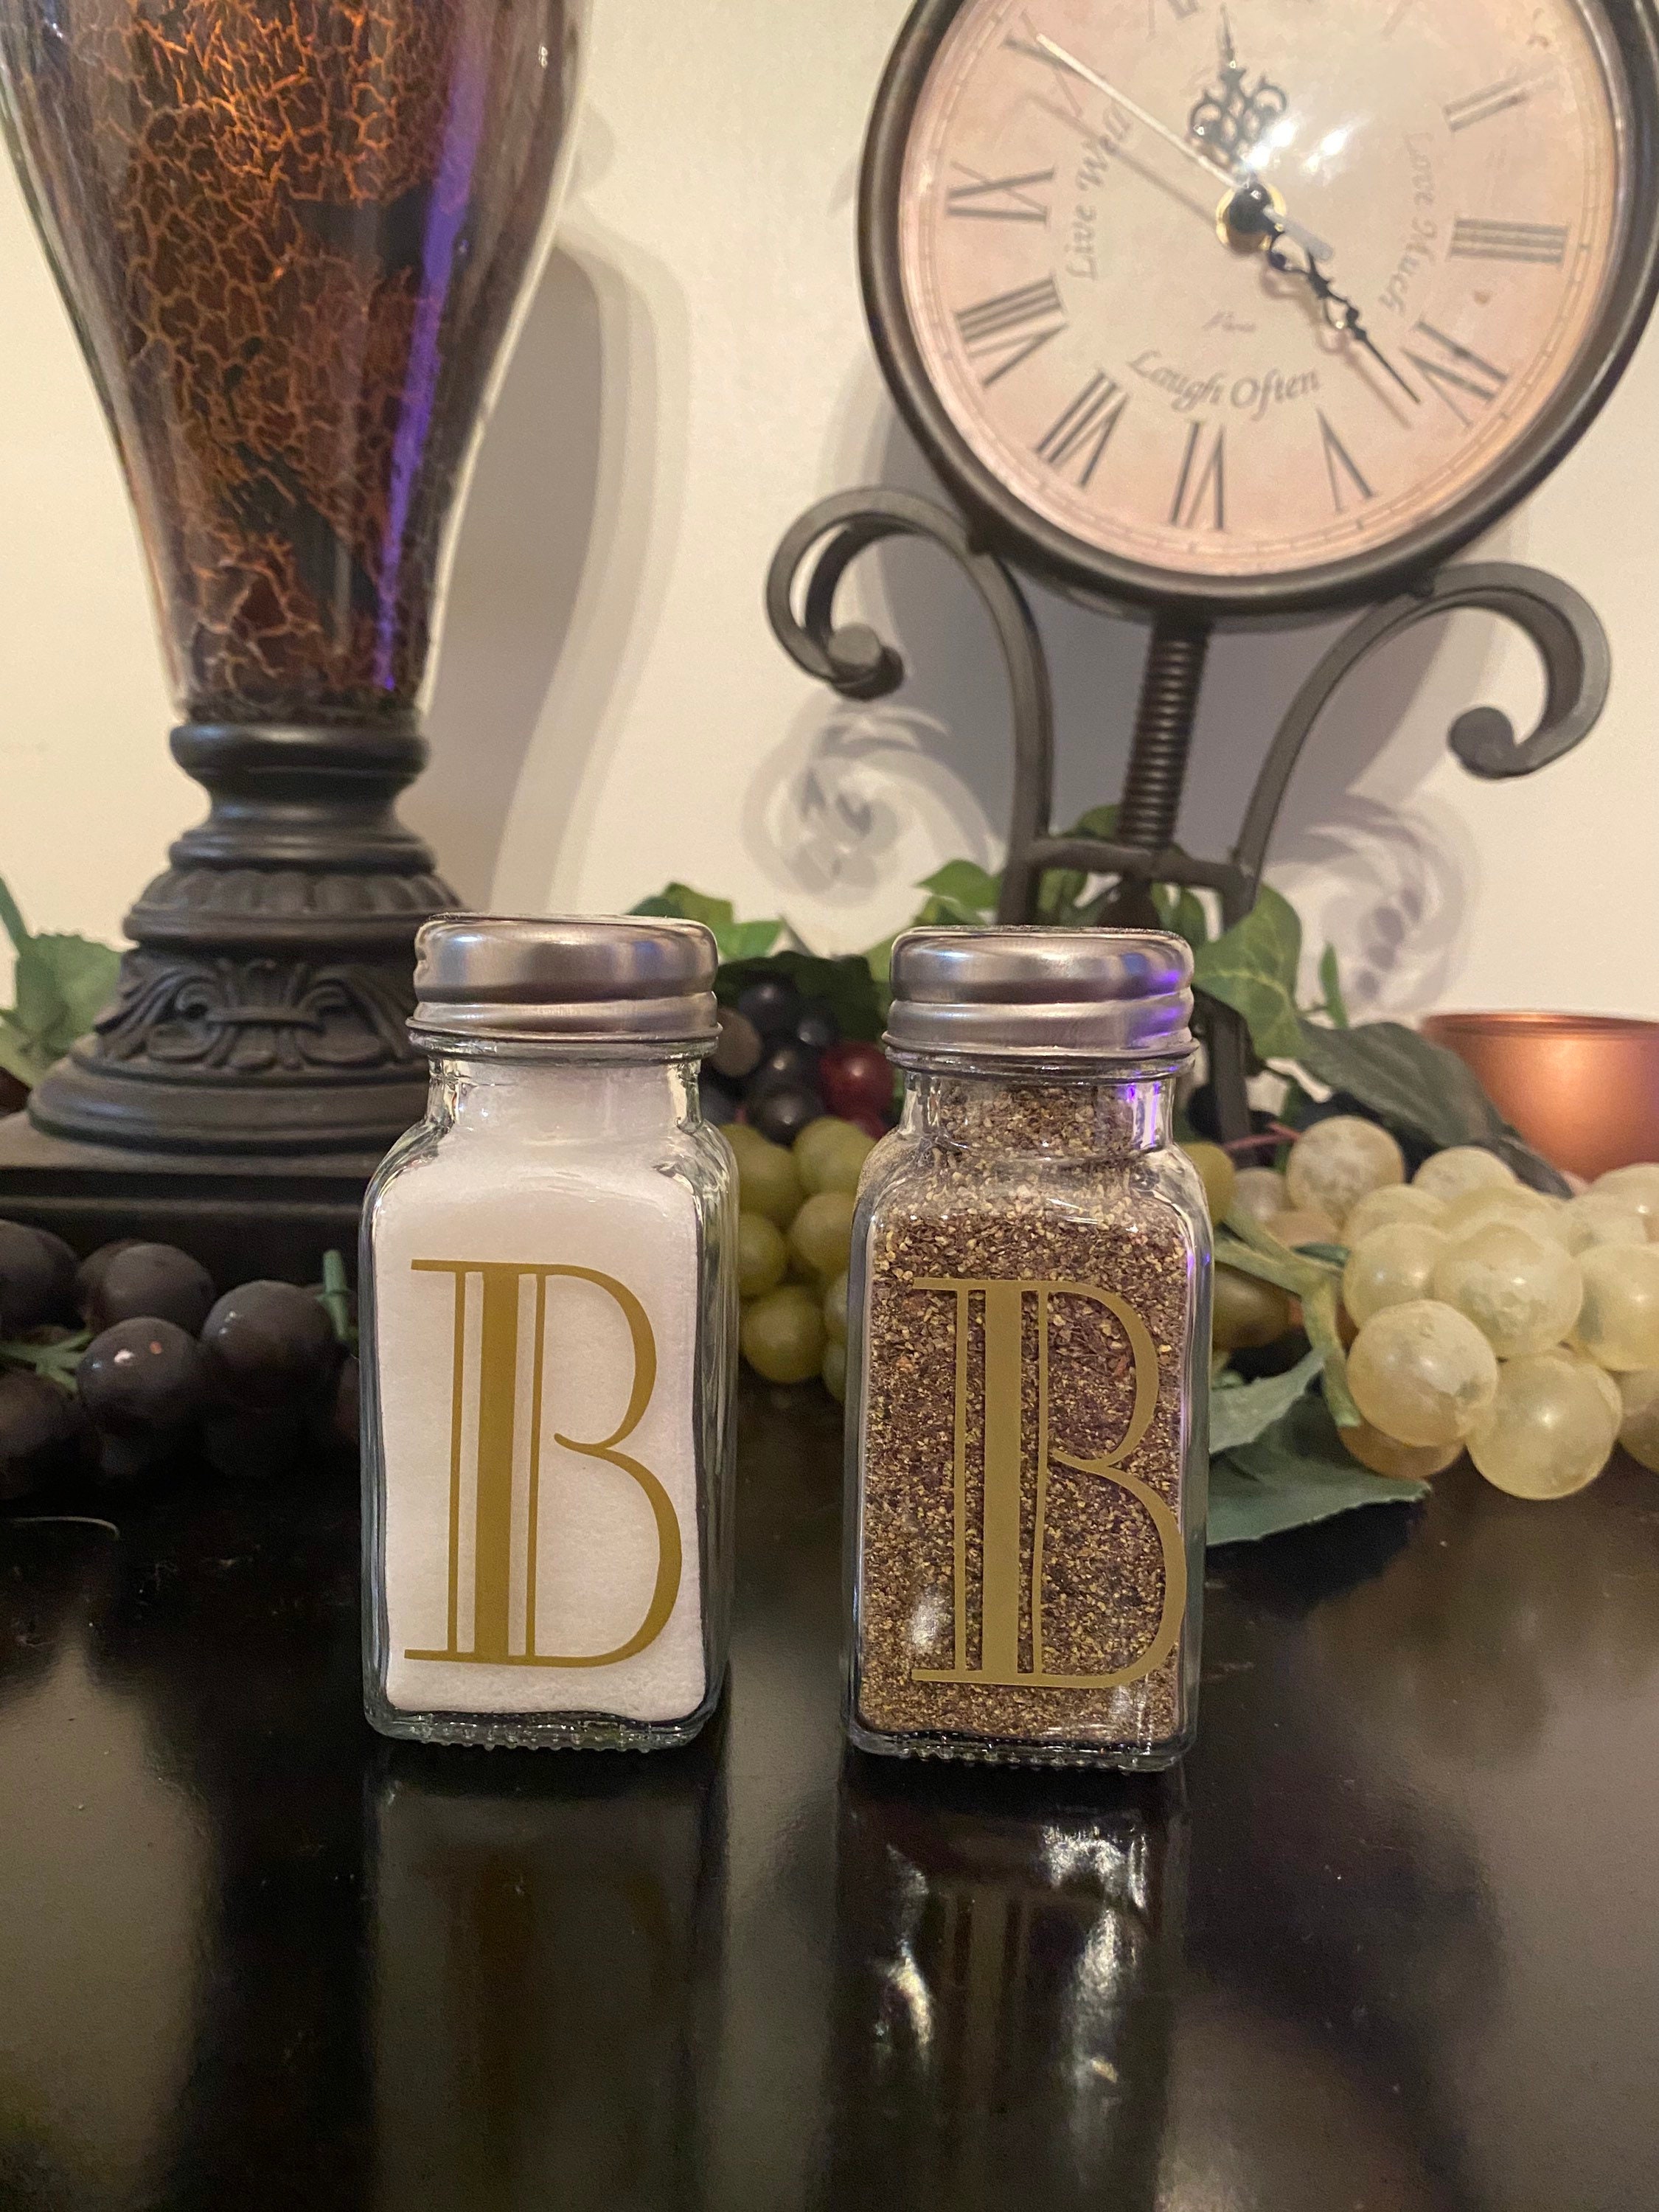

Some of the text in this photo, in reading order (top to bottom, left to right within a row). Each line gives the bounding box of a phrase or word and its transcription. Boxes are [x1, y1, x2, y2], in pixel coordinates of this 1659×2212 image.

[946, 159, 1056, 230] IX
[1065, 204, 1099, 281] Live
[1445, 212, 1569, 271] III
[953, 267, 1069, 391] VIII
[1126, 349, 1321, 422] Laugh Often
[1034, 366, 1131, 493] VII
[1167, 417, 1227, 532] VI
[1315, 402, 1379, 515] V
[405, 1259, 683, 1668] B
[911, 1277, 1187, 1688] B
